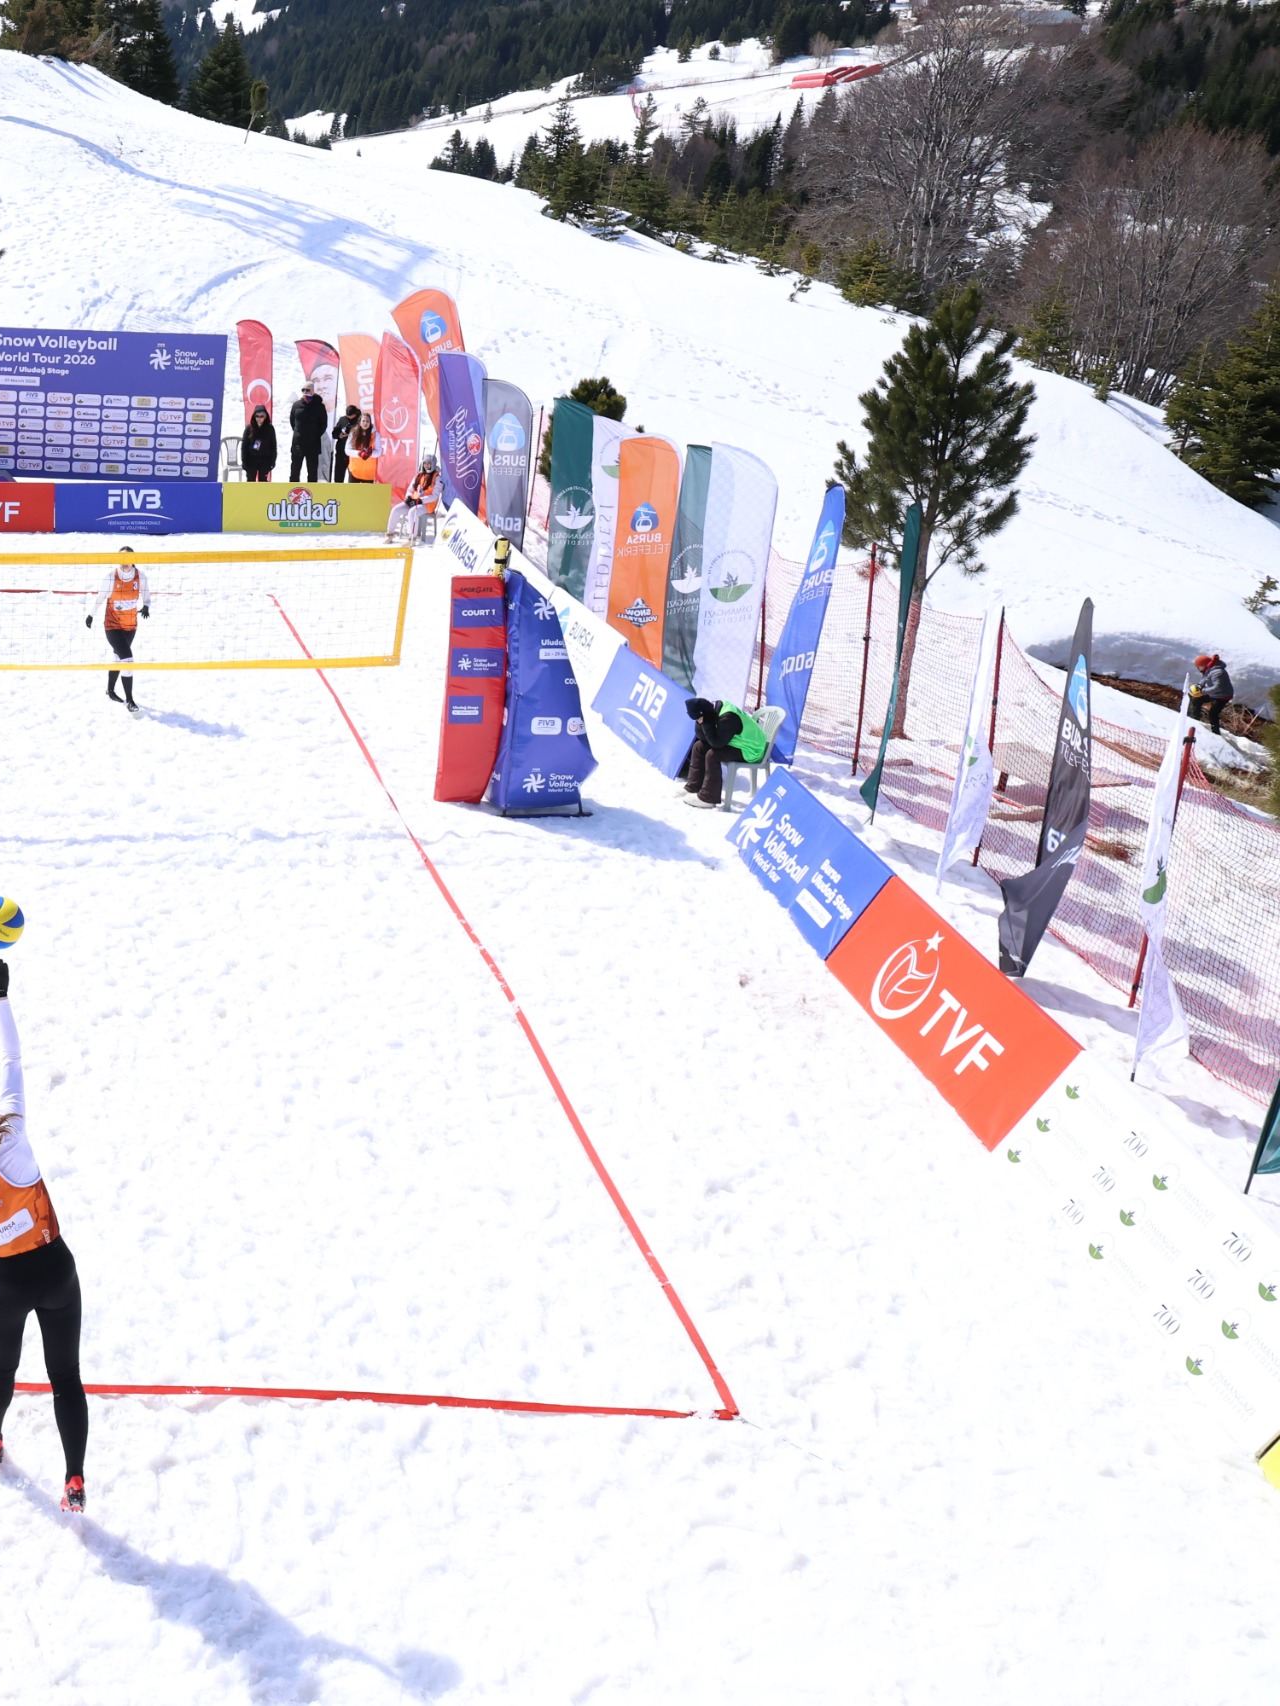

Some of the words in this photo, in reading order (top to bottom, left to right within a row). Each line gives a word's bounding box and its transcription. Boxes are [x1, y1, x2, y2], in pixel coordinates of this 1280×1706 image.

[37, 335, 117, 353] Volleyball
[174, 349, 197, 357] Snow
[13, 365, 17, 374] /
[19, 365, 45, 375] Uludağ
[46, 367, 69, 376] Stage
[32, 352, 61, 364] Tour
[63, 354, 96, 365] 2026
[174, 357, 214, 366] Volleyball
[107, 489, 161, 509] FIVB
[267, 498, 338, 525] uludağ
[132, 580, 137, 590] 3
[568, 621, 595, 651] BURSA
[629, 671, 668, 720] FIVB
[549, 772, 573, 780] Snow
[775, 813, 805, 848] Snow
[752, 849, 770, 873] World
[766, 862, 781, 883] Tour
[762, 830, 809, 884] Volleyball
[820, 858, 842, 884] Bursa
[811, 871, 838, 904] Uludağ
[832, 894, 853, 920] Stage
[919, 988, 1006, 1076] TVF
[1123, 1130, 1148, 1158] 700
[1091, 1166, 1116, 1193] 700
[1061, 1198, 1084, 1226] 700
[1222, 1231, 1252, 1264] 700
[1186, 1269, 1215, 1300] 700
[1152, 1304, 1181, 1335] 700
